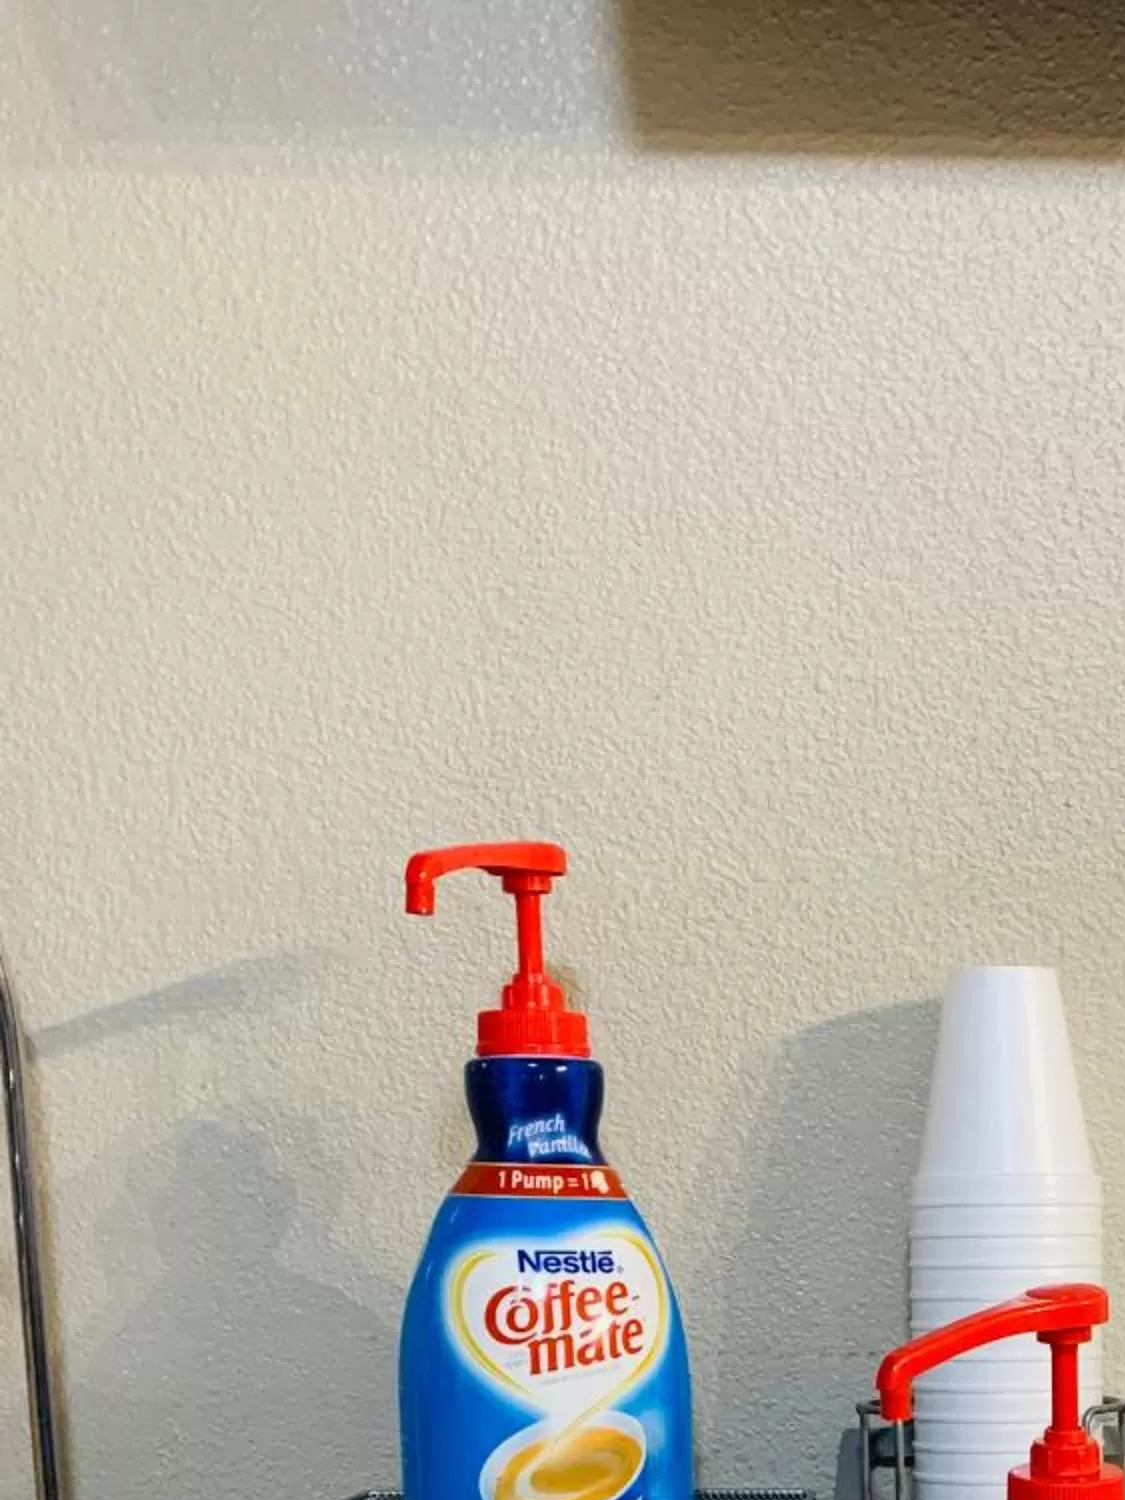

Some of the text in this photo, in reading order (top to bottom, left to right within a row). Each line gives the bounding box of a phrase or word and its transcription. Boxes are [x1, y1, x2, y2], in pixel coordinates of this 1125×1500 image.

[508, 1113, 566, 1148] French
[527, 1135, 592, 1158] Vanilla
[498, 1171, 506, 1189] 1
[511, 1170, 564, 1194] Pump
[528, 1317, 645, 1376] mate
